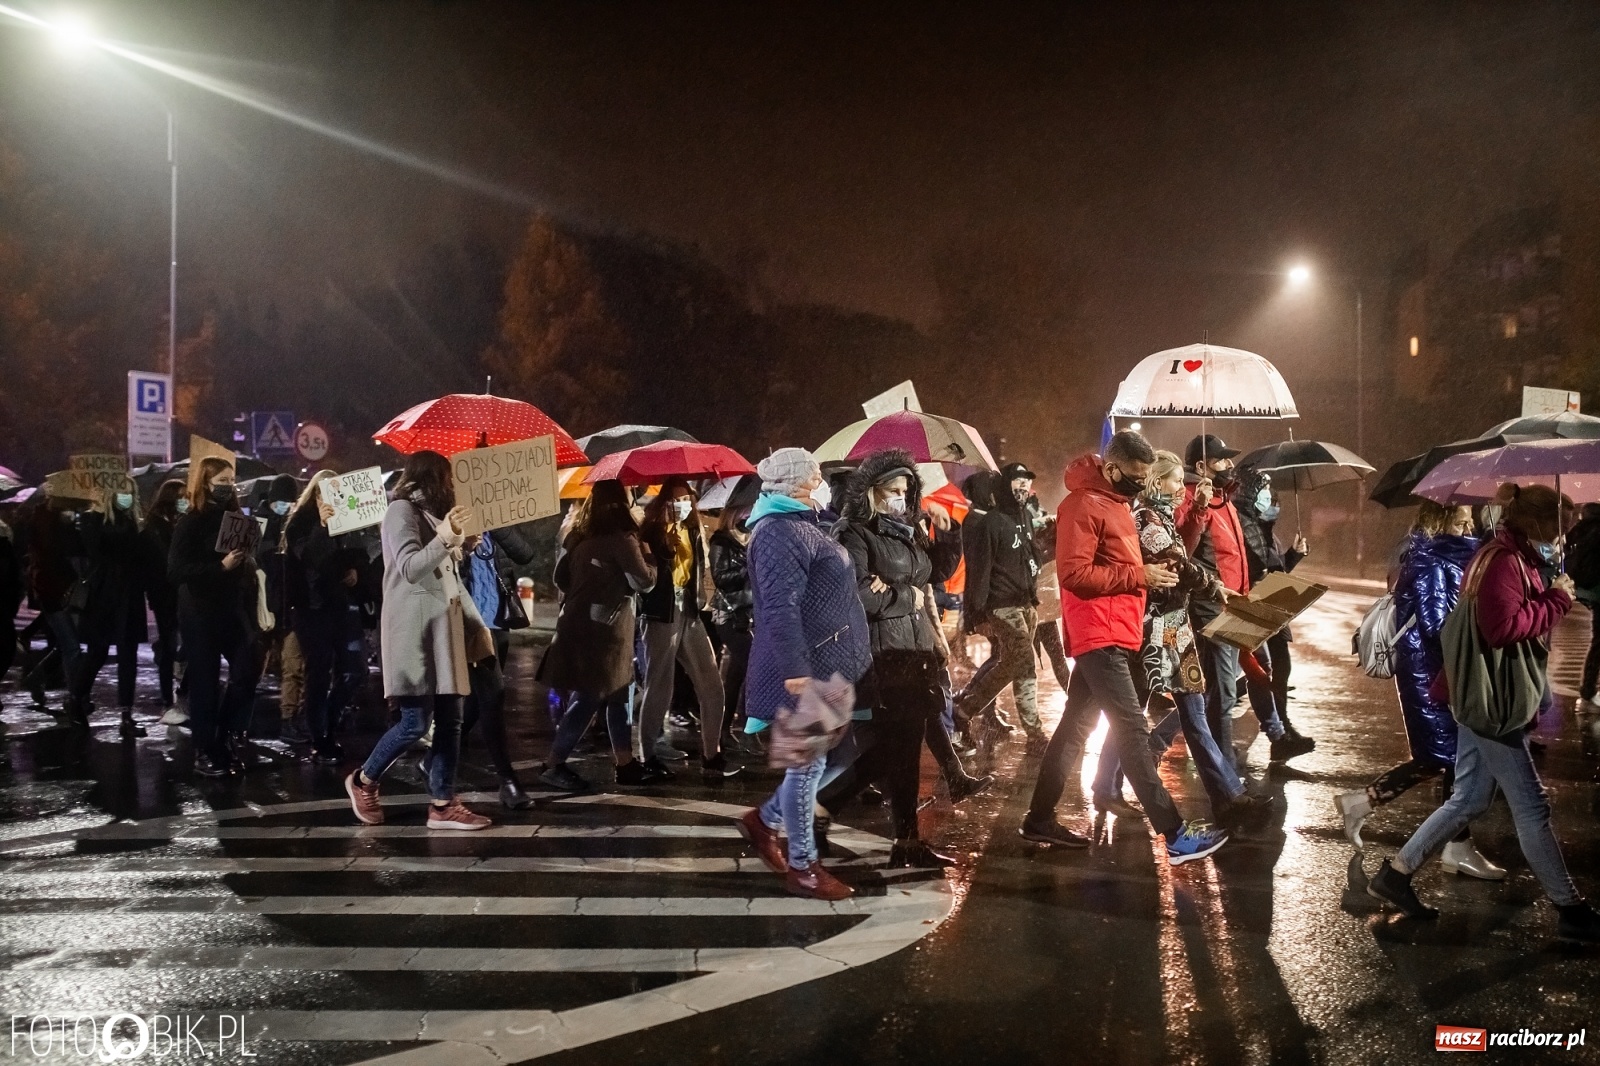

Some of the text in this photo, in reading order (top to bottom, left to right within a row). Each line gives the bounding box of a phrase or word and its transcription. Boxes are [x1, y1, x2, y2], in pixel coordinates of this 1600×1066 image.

[1169, 359, 1182, 375] I
[143, 382, 161, 409] P
[505, 444, 553, 475] DZIADU
[342, 471, 372, 487] STRAJK
[351, 479, 375, 495] KOBIET
[481, 496, 537, 528] W LEGO
